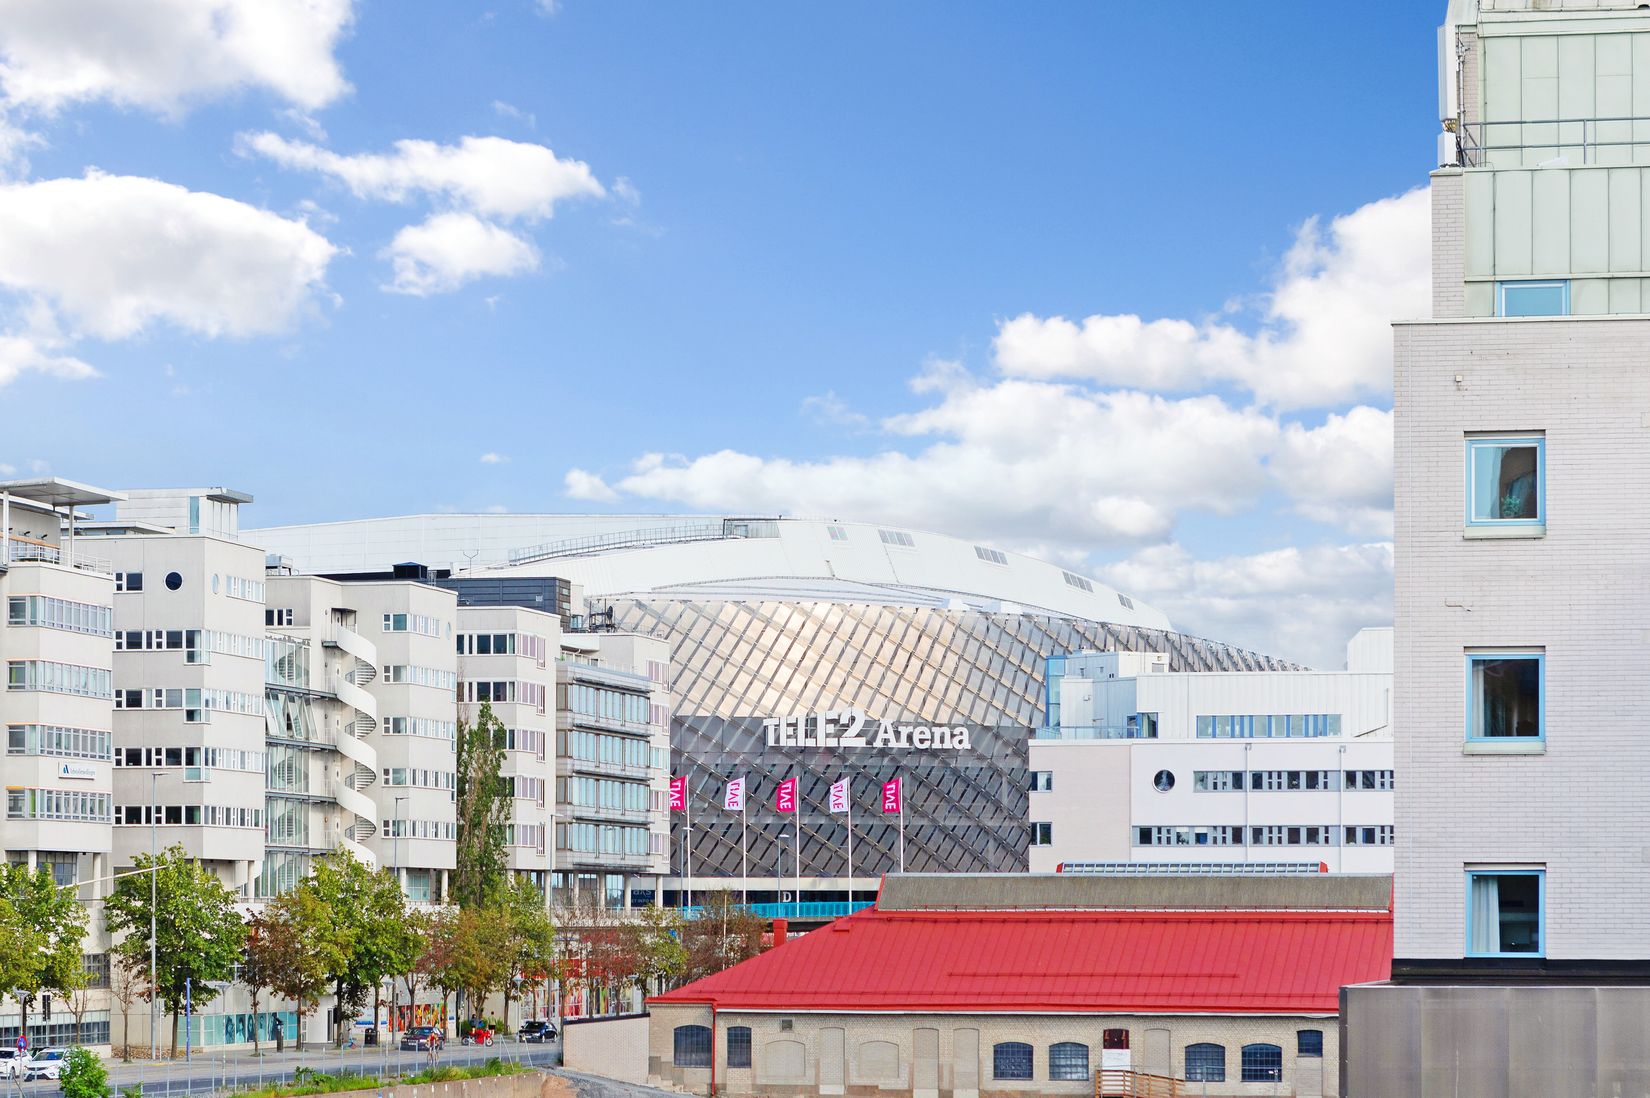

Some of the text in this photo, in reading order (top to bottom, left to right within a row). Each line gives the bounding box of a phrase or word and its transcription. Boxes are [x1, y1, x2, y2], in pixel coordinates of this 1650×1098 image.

[763, 707, 972, 750] TELE2 Arena
[782, 891, 792, 903] D
